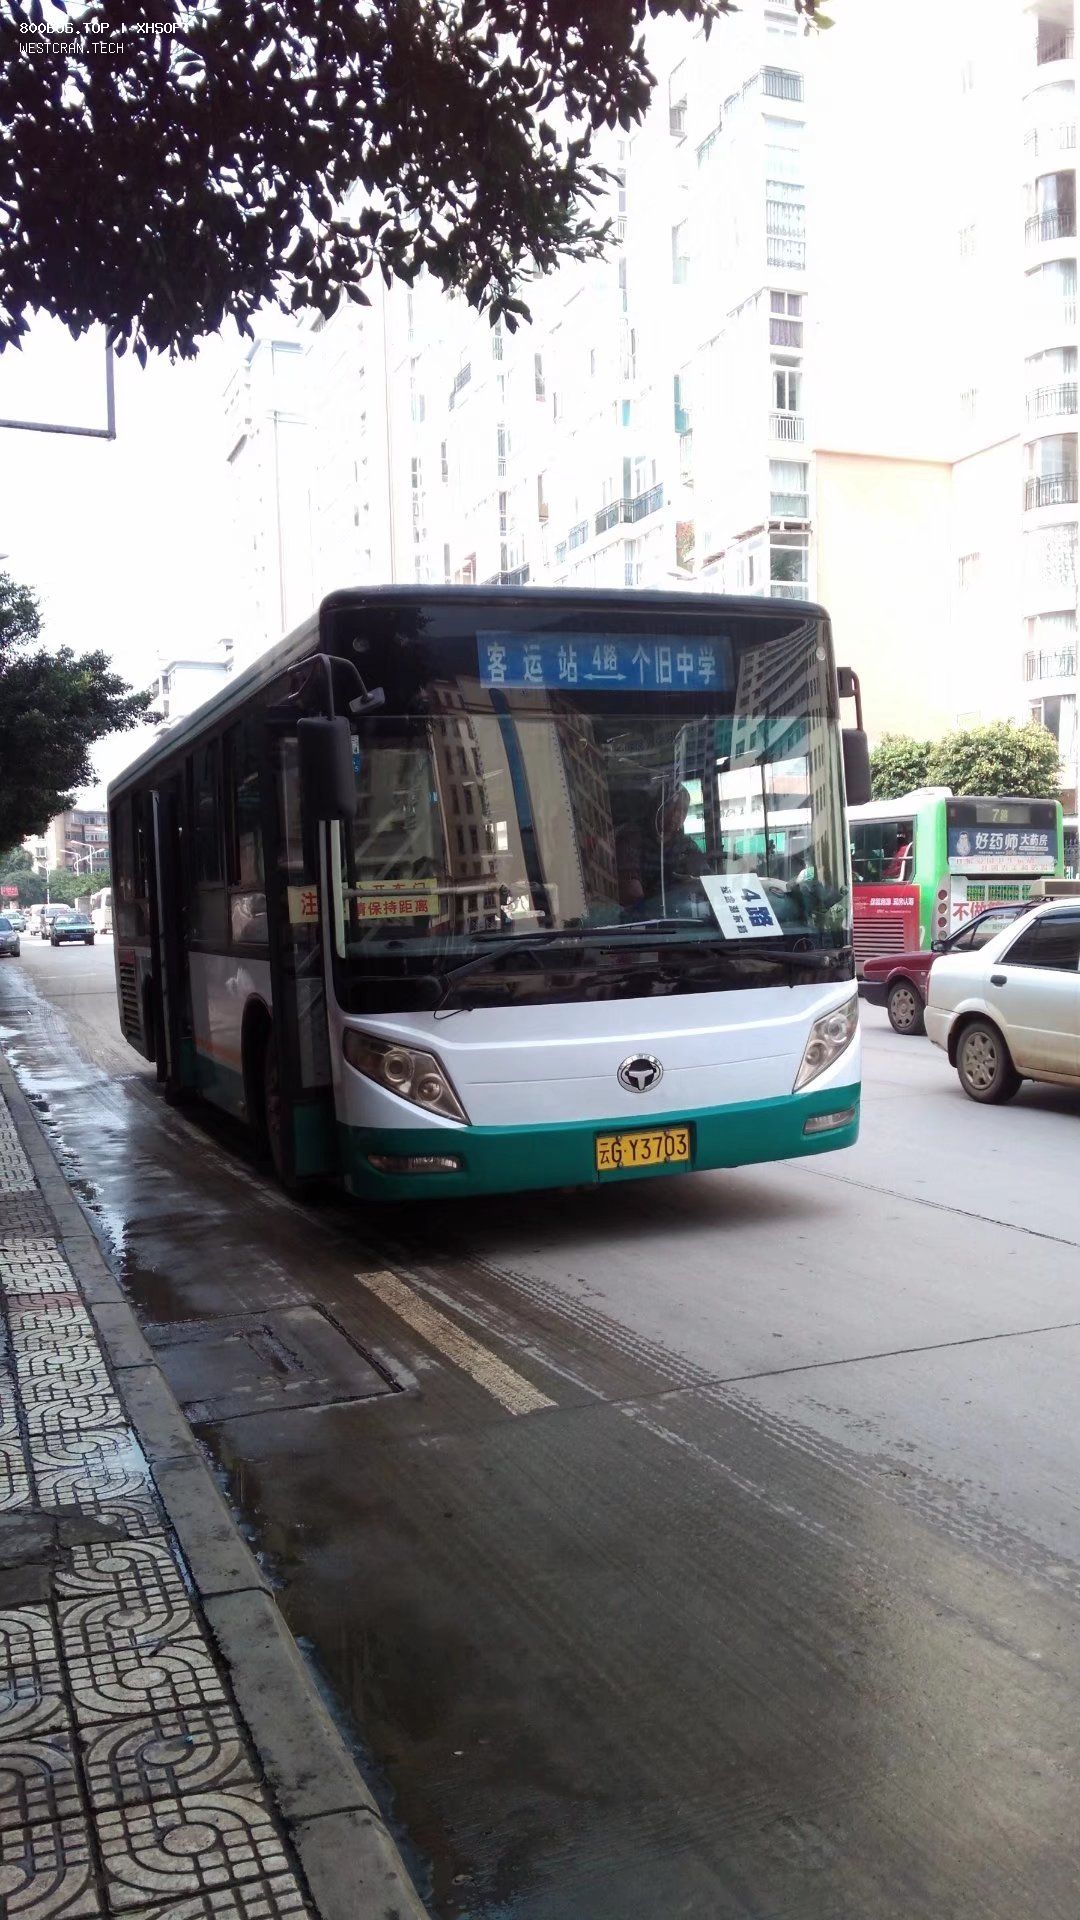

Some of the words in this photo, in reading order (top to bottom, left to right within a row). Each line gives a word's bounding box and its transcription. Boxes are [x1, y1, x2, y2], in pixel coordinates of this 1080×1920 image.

[487, 642, 578, 683] 客运站
[592, 645, 618, 671] 4路
[632, 643, 717, 685] 个旧中学
[301, 891, 319, 916] 注
[740, 888, 774, 928] 4路
